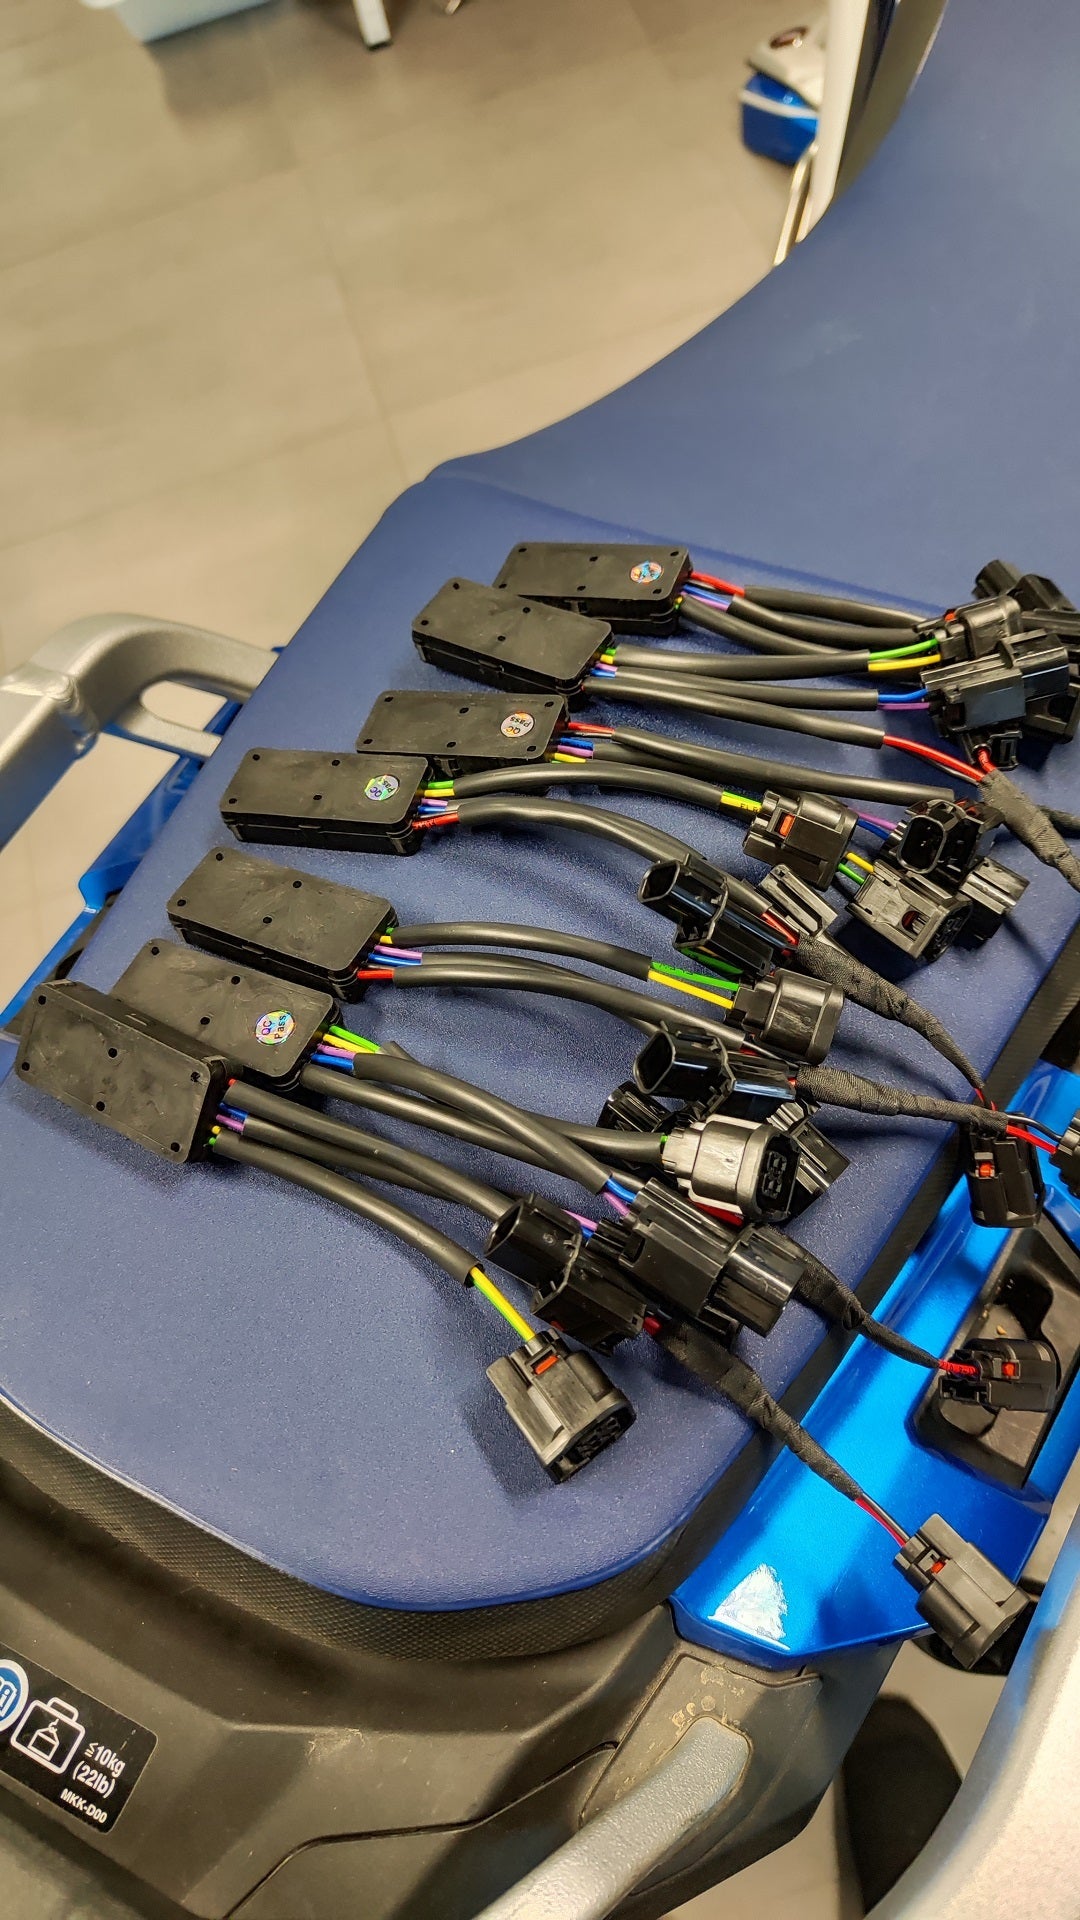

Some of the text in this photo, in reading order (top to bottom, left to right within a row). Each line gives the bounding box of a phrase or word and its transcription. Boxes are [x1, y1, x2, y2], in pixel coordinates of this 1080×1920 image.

[261, 1020, 273, 1036] QC
[274, 1015, 287, 1039] Pass
[72, 1760, 116, 1798] (22lb)
[60, 1788, 108, 1824] MKK-D00
